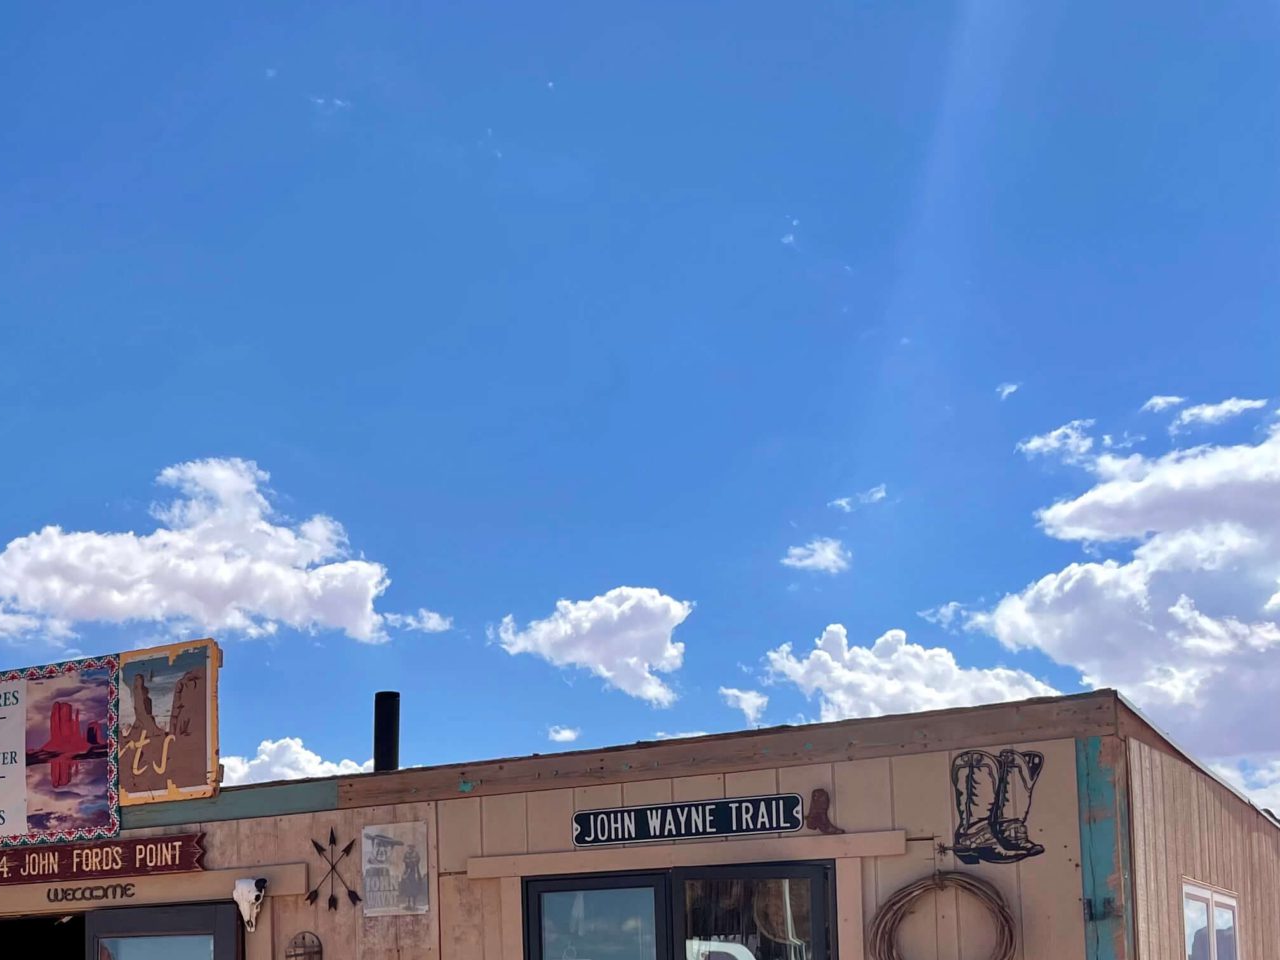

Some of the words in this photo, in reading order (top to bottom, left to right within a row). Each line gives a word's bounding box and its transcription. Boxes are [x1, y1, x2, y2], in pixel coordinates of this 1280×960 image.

[585, 812, 636, 842] JOHN
[647, 804, 717, 836] WAYNE
[729, 799, 791, 831] TRAIL
[20, 852, 59, 876] JOHN
[135, 841, 182, 867] POINT
